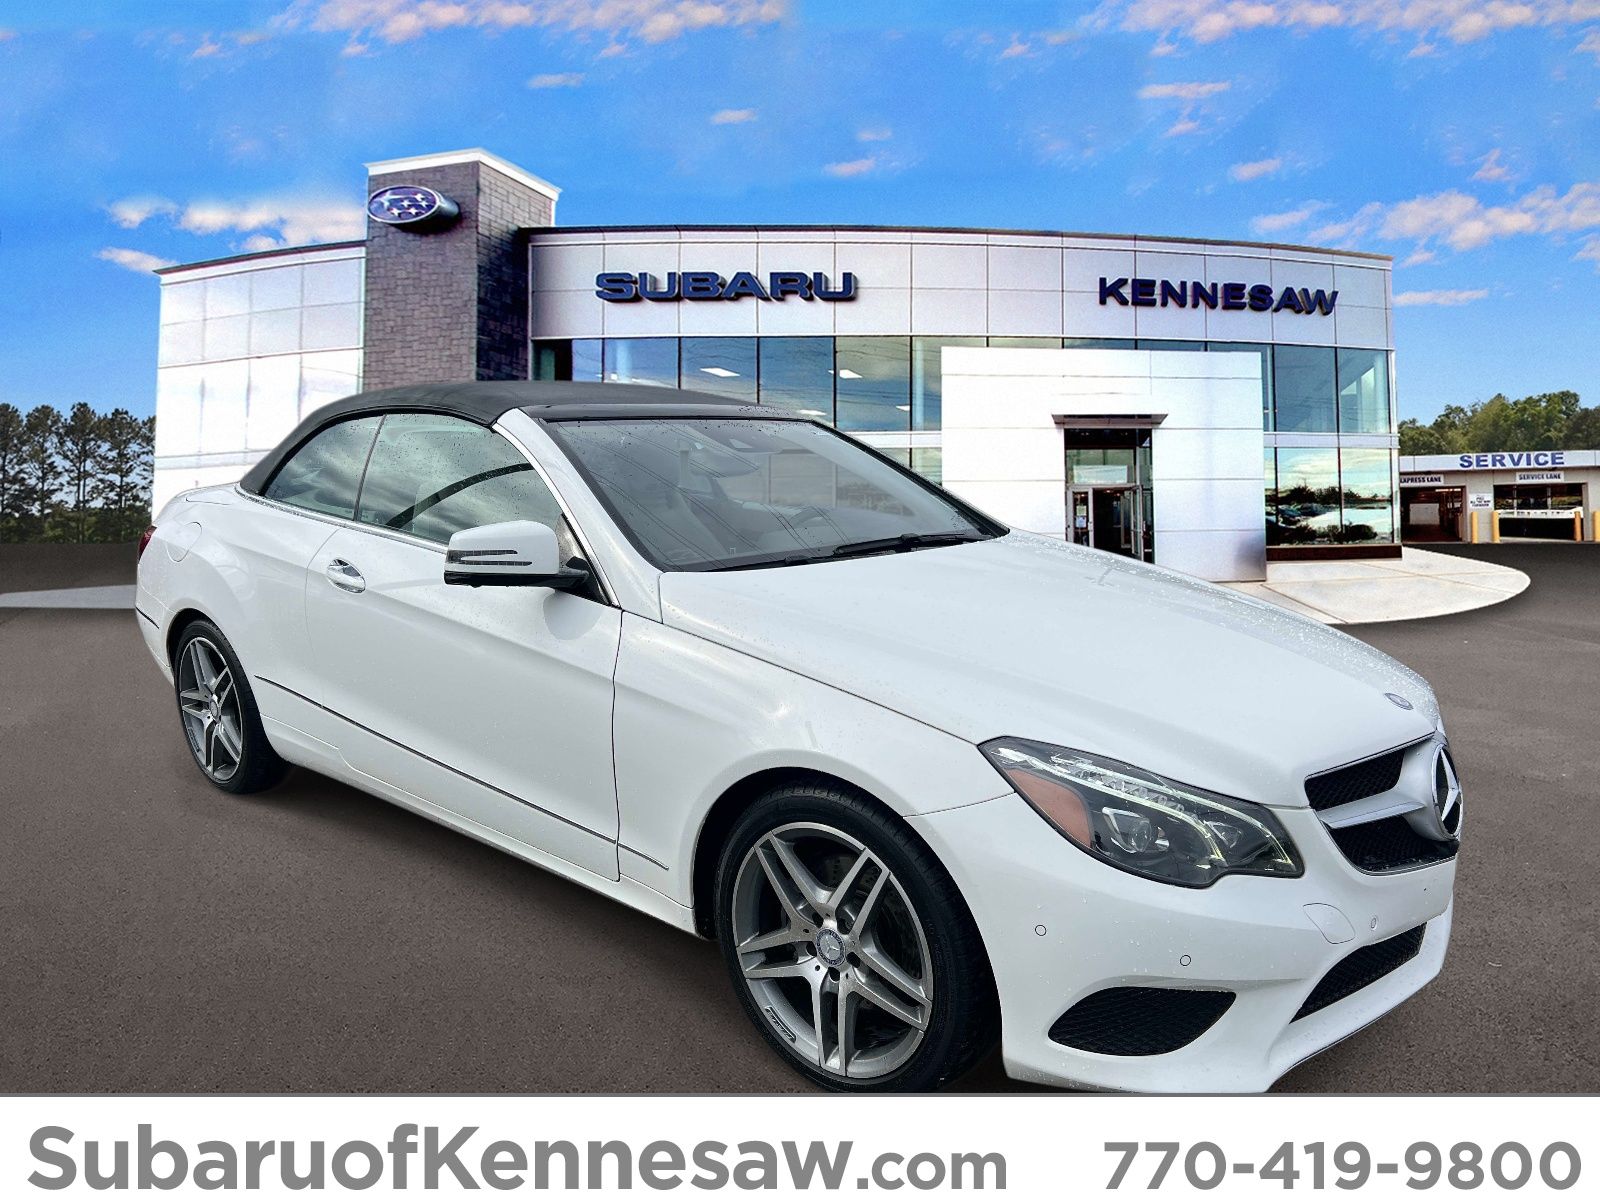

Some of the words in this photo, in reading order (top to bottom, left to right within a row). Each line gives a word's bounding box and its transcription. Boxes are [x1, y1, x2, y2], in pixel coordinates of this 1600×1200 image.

[595, 271, 858, 302] SUBARU
[1098, 277, 1339, 316] KENNESAW
[1459, 452, 1565, 469] SERVICE
[1518, 473, 1545, 481] SERVICE
